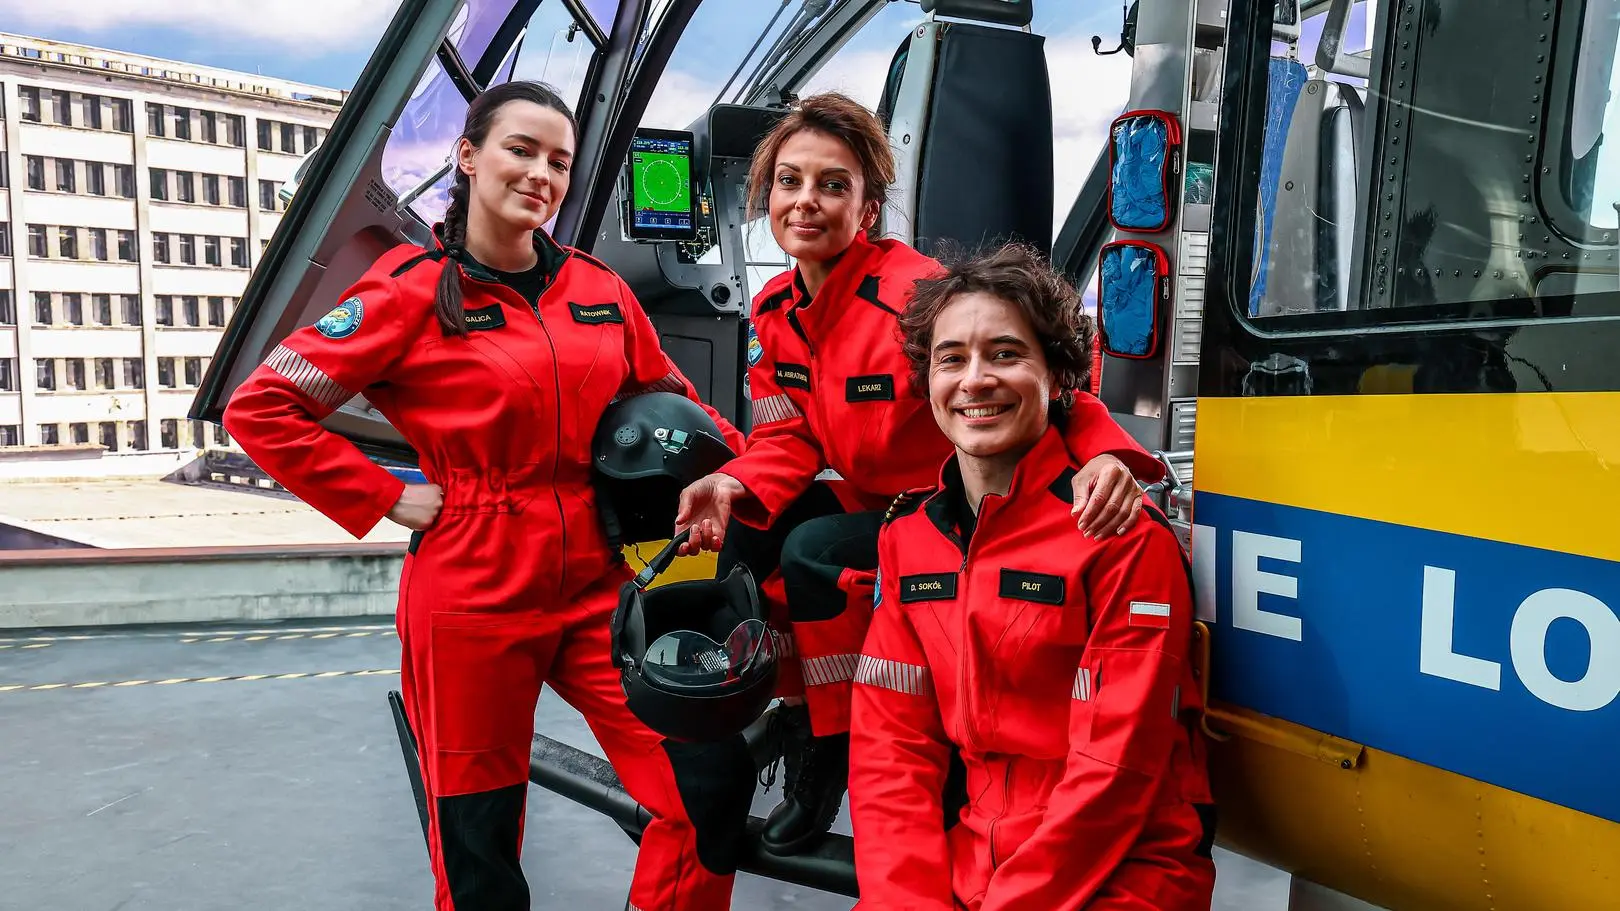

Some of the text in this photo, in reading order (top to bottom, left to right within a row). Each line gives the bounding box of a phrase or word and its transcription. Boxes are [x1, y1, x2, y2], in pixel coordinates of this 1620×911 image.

[465, 314, 491, 323] GALICA
[579, 309, 611, 318] RATOWNIK
[857, 383, 882, 393] LEKARZ
[910, 580, 942, 592] D. SOKÓŁ
[1021, 581, 1042, 592] PILOT
[1420, 564, 1620, 712] LO
